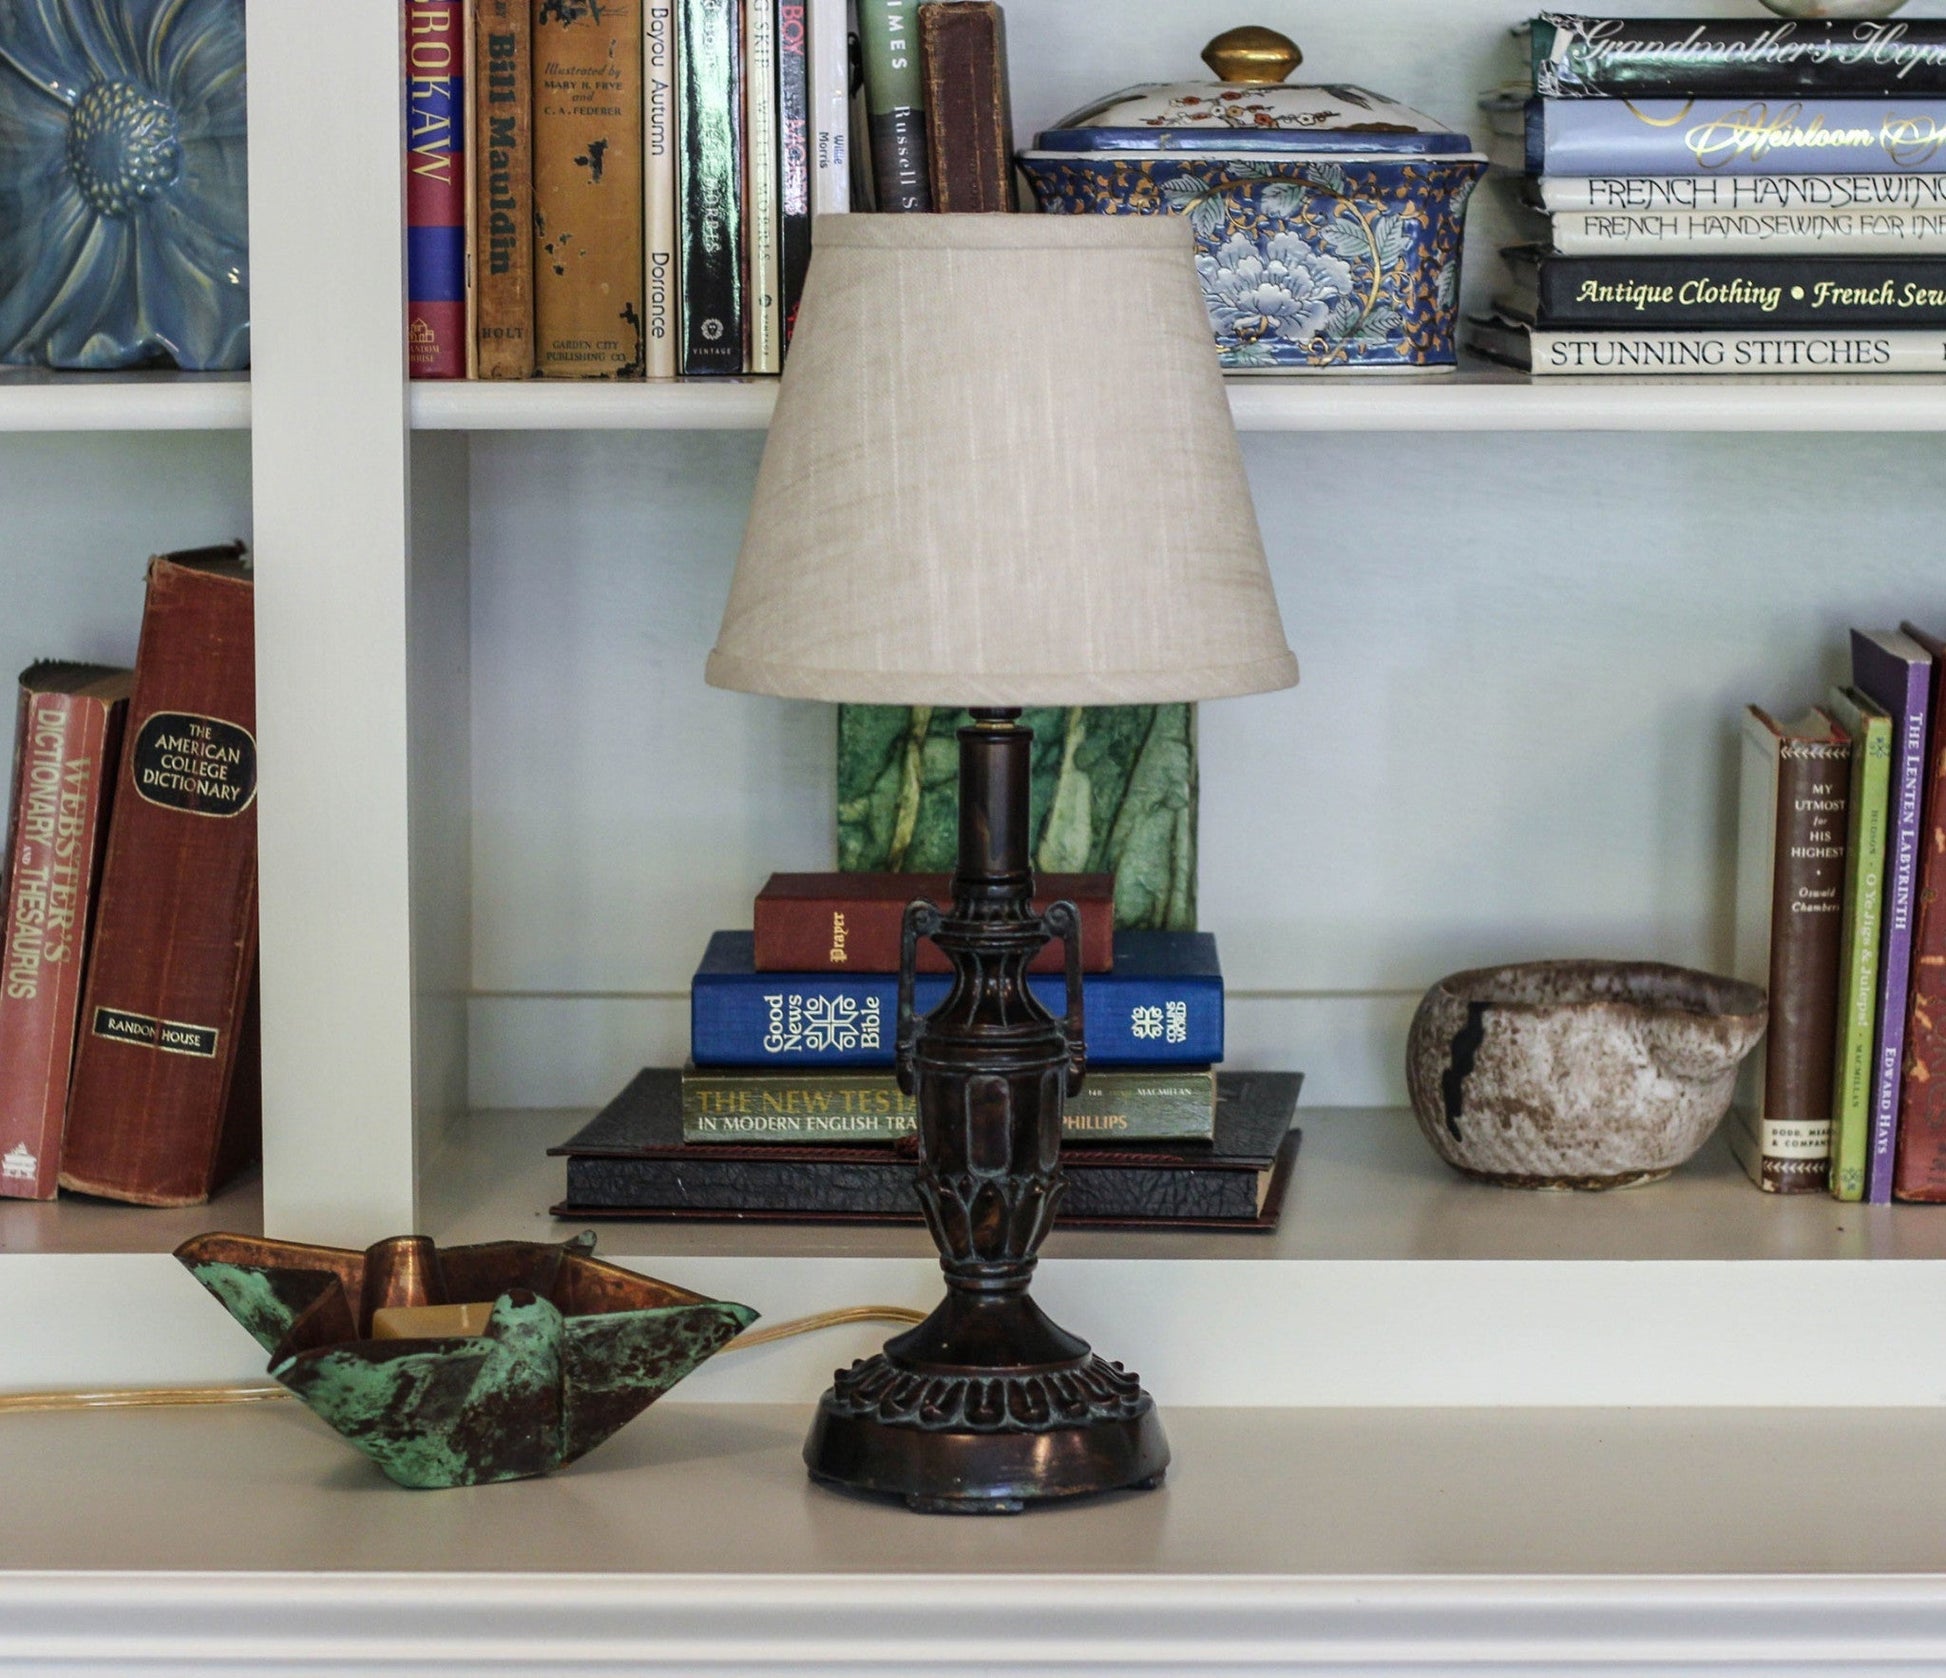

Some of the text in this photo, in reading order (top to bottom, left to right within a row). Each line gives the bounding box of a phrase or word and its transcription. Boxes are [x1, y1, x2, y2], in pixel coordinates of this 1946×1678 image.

[754, 22, 770, 69] SKIP
[783, 5, 805, 55] BOY
[1573, 19, 1832, 64] Grandmother's
[544, 81, 576, 90] MARY
[545, 63, 622, 79] Illustrated by
[647, 8, 669, 155] Bayou Autumn
[410, 0, 452, 186] ROKAW
[572, 91, 595, 101] and
[818, 132, 829, 169] Morris
[833, 134, 844, 165] Willie
[894, 105, 917, 186] Russell
[1684, 101, 1877, 168] Heirloom
[489, 33, 517, 275] Bill Mauldin
[1589, 178, 1718, 209] FRENCH
[1585, 215, 1678, 240] FRENCH
[1688, 215, 1852, 240] HANDSEWING
[1860, 215, 1905, 239] FOR
[651, 252, 670, 339] Dorrance
[1576, 279, 1674, 310] Antique
[1679, 278, 1783, 312] Clothing
[1810, 279, 1895, 308] French
[482, 327, 524, 341] HOLT
[552, 340, 591, 350] GARDEN
[546, 351, 606, 361] PUBLISHING
[692, 347, 731, 355] VINTAGE
[1550, 340, 1890, 366] STUNNING STITCHES
[189, 723, 212, 740] THE
[154, 734, 241, 764] AMERICAN
[25, 709, 66, 848] DICTIONARY
[161, 754, 228, 780] COLLEGE
[143, 768, 241, 801] DICTIONARY
[1812, 783, 1833, 795] MY
[1795, 799, 1845, 811] UTMOST
[1813, 815, 1829, 827] for
[1895, 711, 1924, 930] THE LENTEN LABYRINTH
[1791, 846, 1844, 858] HIGHEST
[1809, 830, 1832, 842] HIS
[45, 757, 90, 964] WEBSTER'S
[1799, 886, 1836, 898] Oswald
[7, 867, 49, 1000] THESAURUS
[830, 911, 849, 963] Prayer
[1861, 948, 1873, 962] &
[1856, 965, 1871, 1027] Juleps!
[763, 993, 784, 1053] Good
[783, 994, 802, 1052] News
[861, 996, 880, 1049] Bible
[1166, 1000, 1176, 1043] COLLINS
[1176, 1001, 1187, 1042] WORLD
[161, 1029, 201, 1047] HOUSE
[697, 1090, 751, 1113] THE
[762, 1090, 832, 1113] NEW
[1878, 1046, 1897, 1154] EDWARD HAYS
[699, 1116, 918, 1131] IN MODERN ENGLISH TRA
